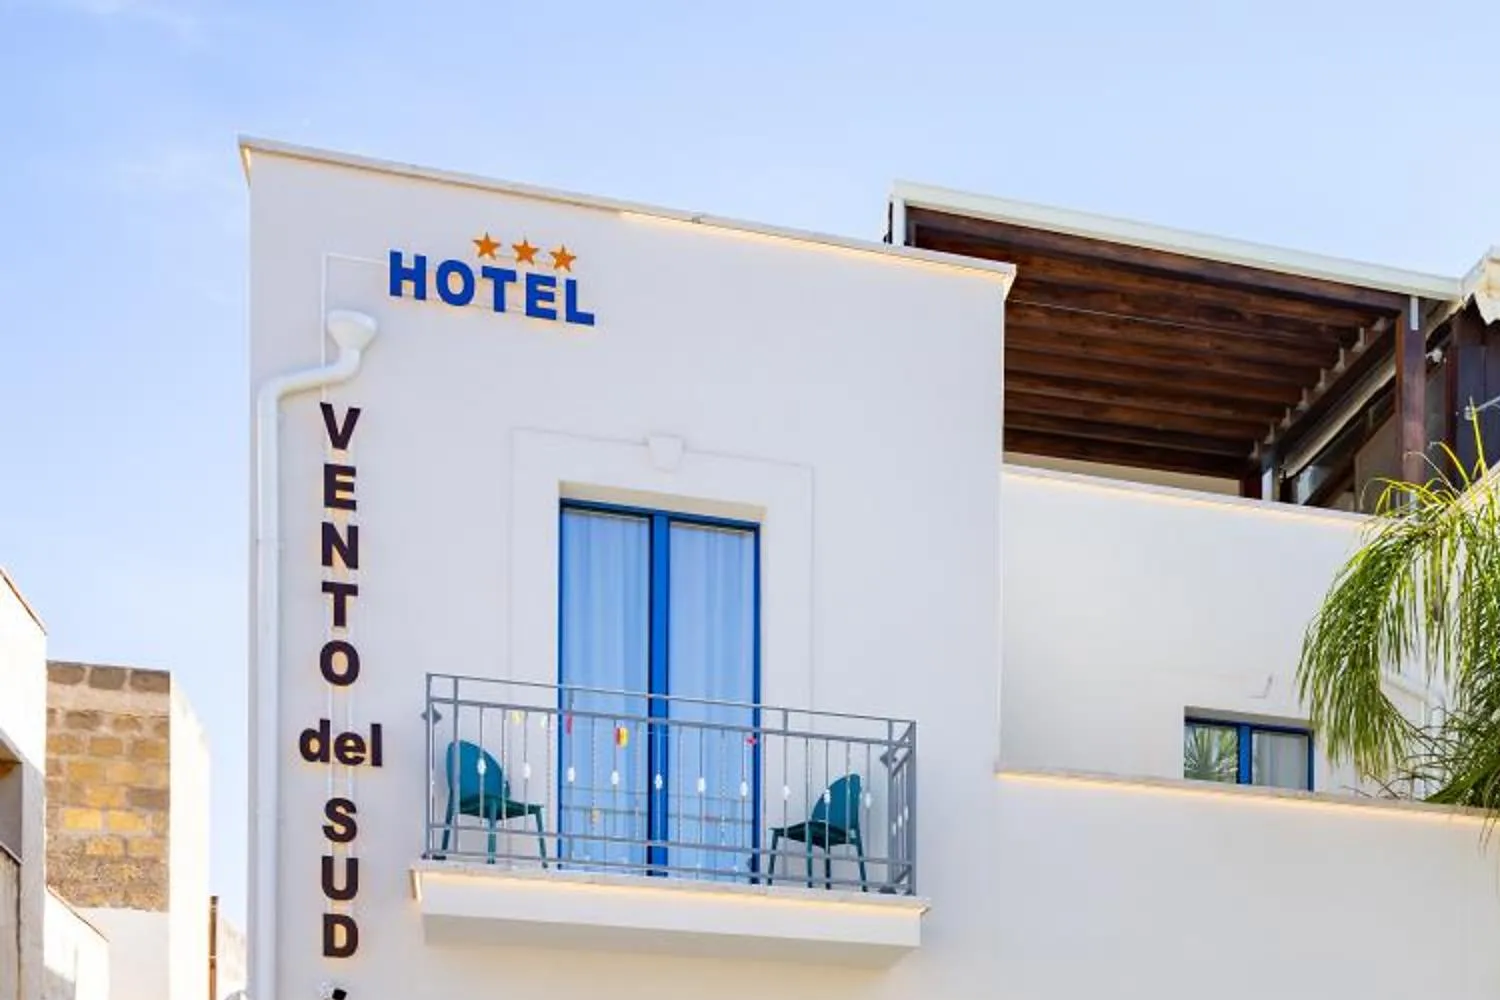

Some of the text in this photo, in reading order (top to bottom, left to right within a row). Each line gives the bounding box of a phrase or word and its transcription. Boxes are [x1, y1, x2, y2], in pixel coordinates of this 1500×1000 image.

[389, 250, 596, 326] HOTEL
[298, 402, 383, 958] VENTO del SUD
